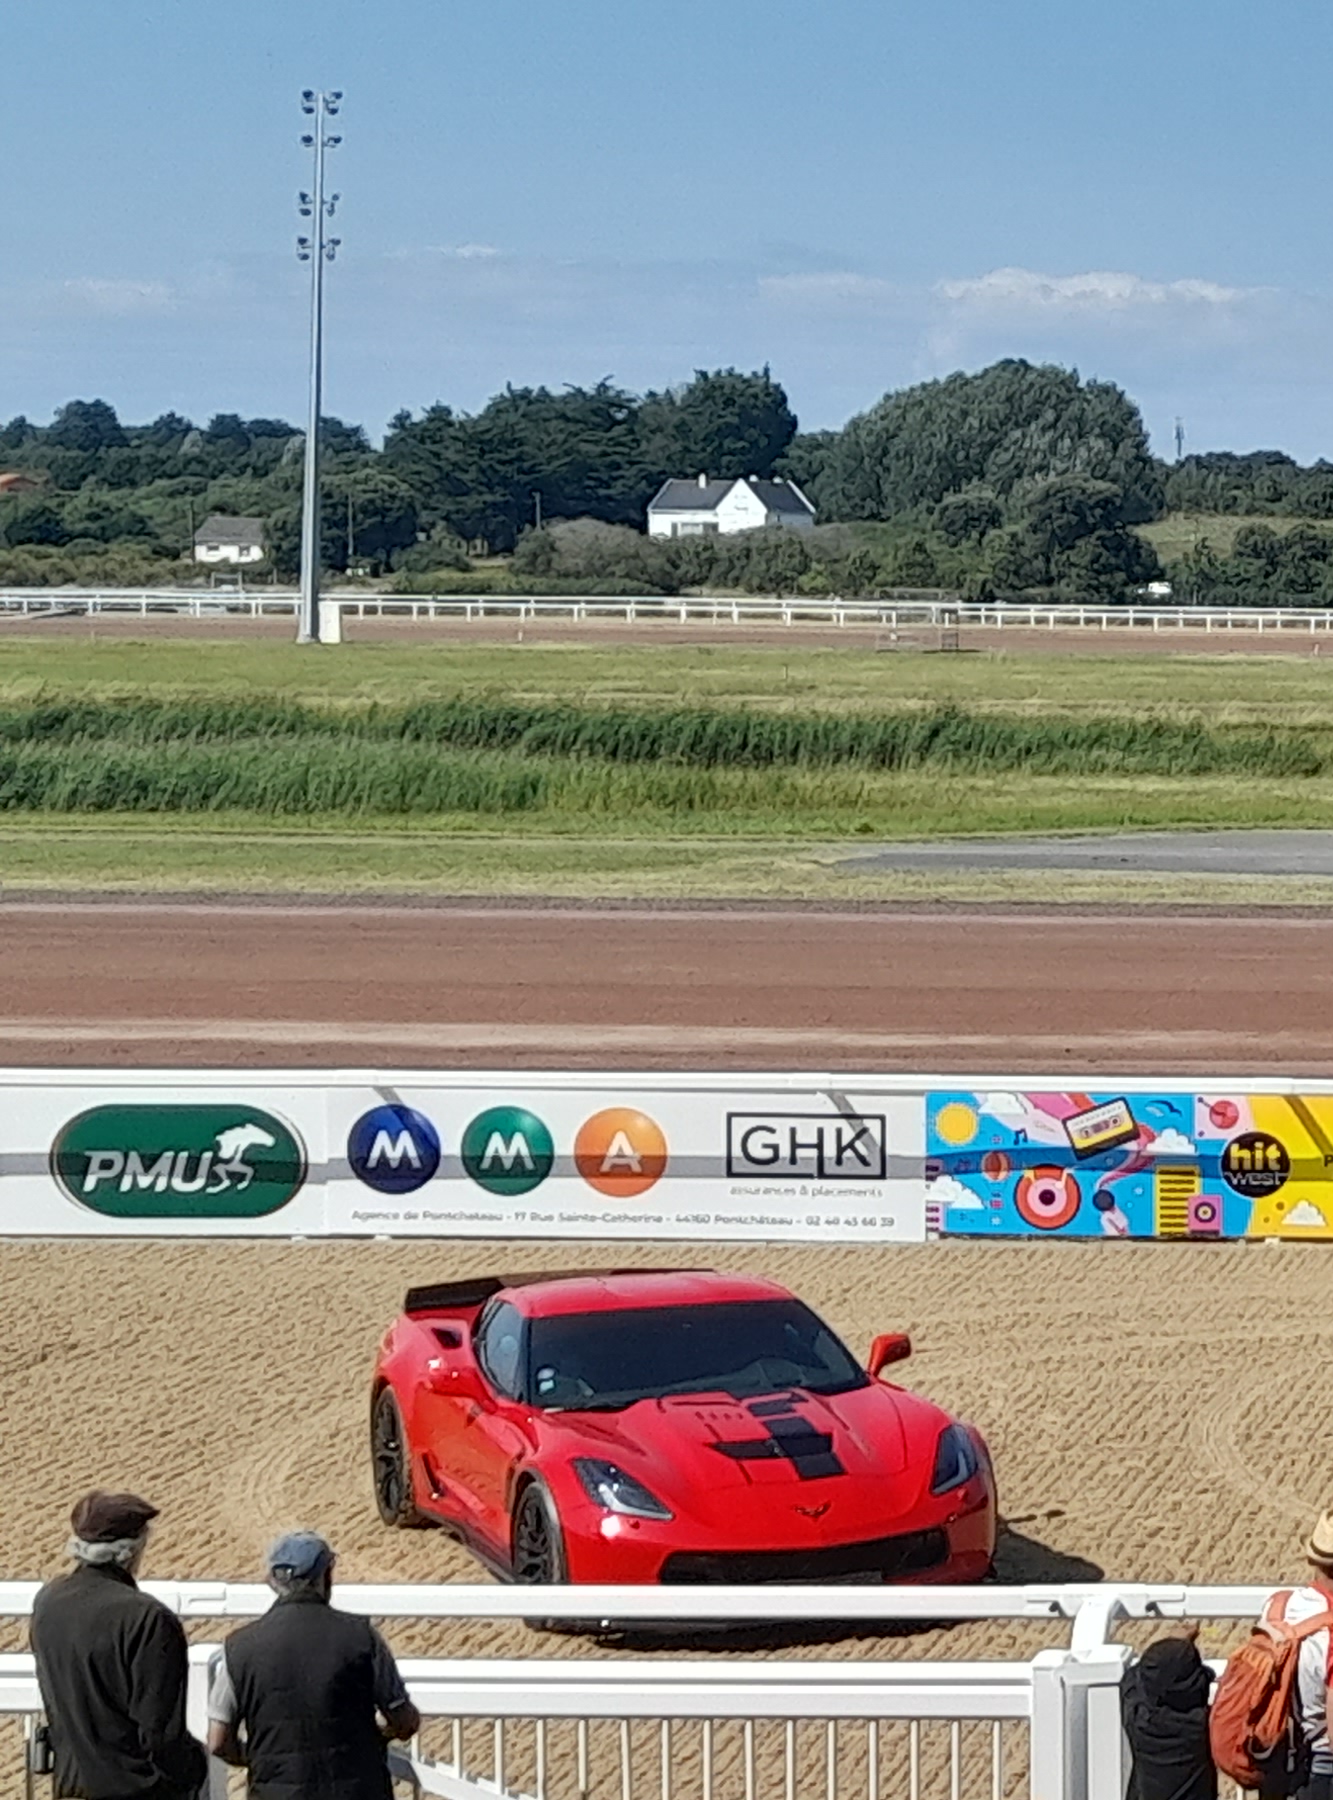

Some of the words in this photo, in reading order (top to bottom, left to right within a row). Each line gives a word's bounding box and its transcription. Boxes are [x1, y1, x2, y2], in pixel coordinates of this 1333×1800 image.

[740, 1124, 872, 1168] GHK
[1229, 1141, 1282, 1171] hit
[82, 1149, 214, 1194] PMU
[1224, 1171, 1290, 1186] west
[729, 1185, 797, 1197] assurances
[811, 1185, 884, 1198] placements
[351, 1210, 400, 1223] Agence
[530, 1212, 554, 1222] Rue
